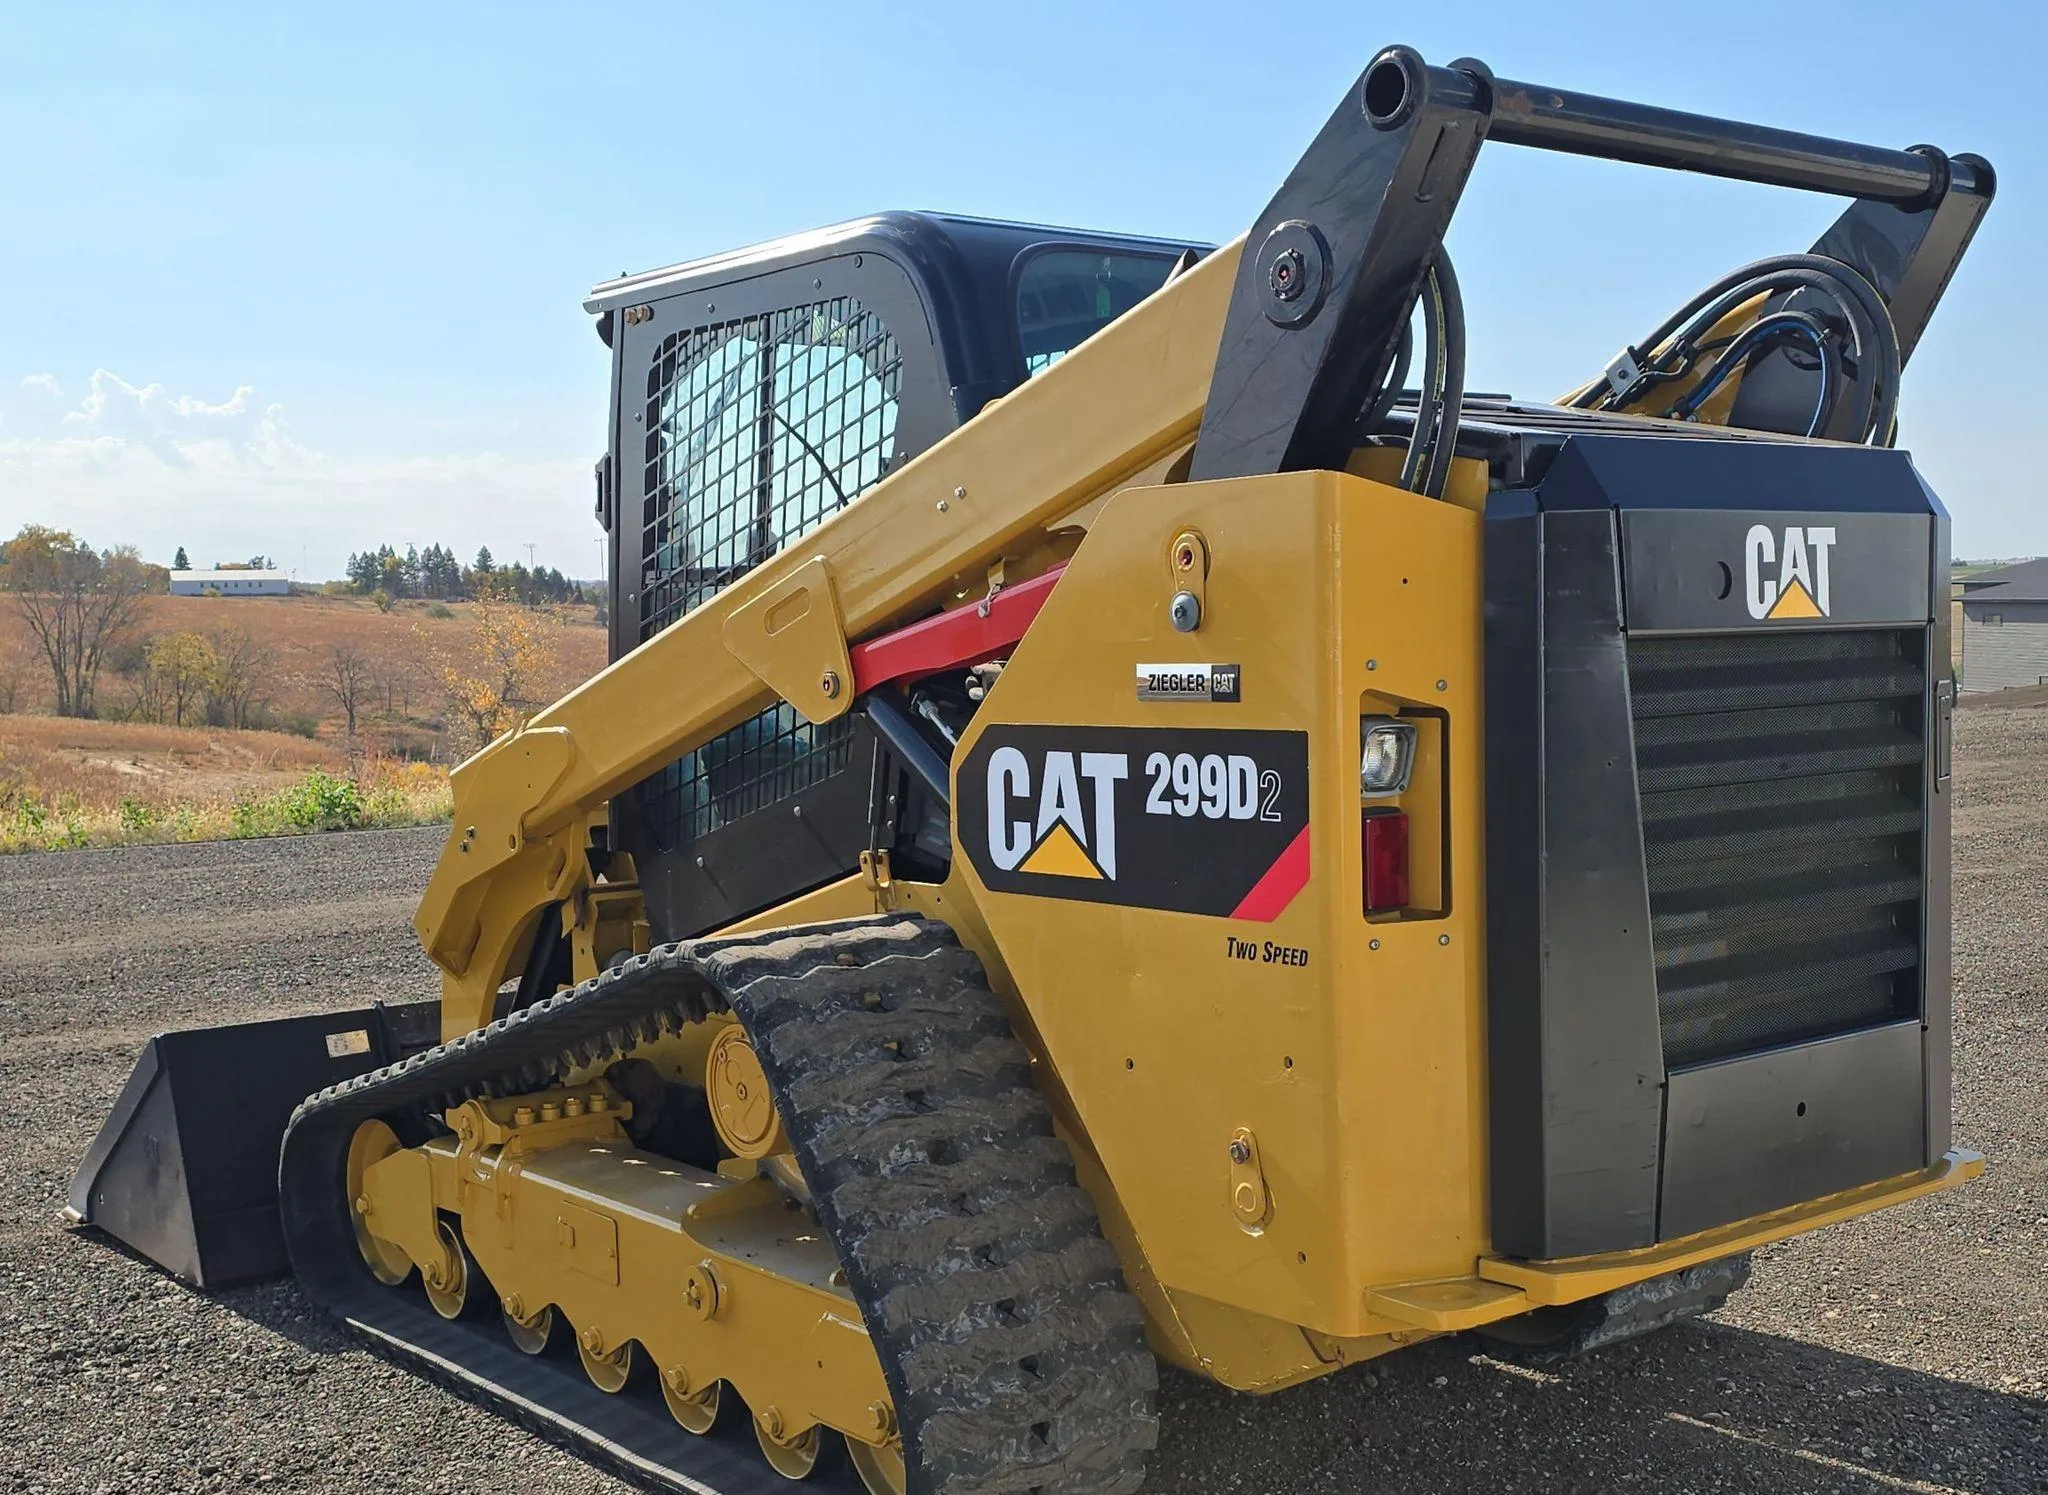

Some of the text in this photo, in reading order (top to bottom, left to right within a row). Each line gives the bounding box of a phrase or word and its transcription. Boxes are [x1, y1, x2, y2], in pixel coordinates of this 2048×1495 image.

[1745, 524, 1836, 620] CAT
[1148, 673, 1235, 693] ZIEGLER CAT
[987, 746, 1282, 881] CAT 299D2
